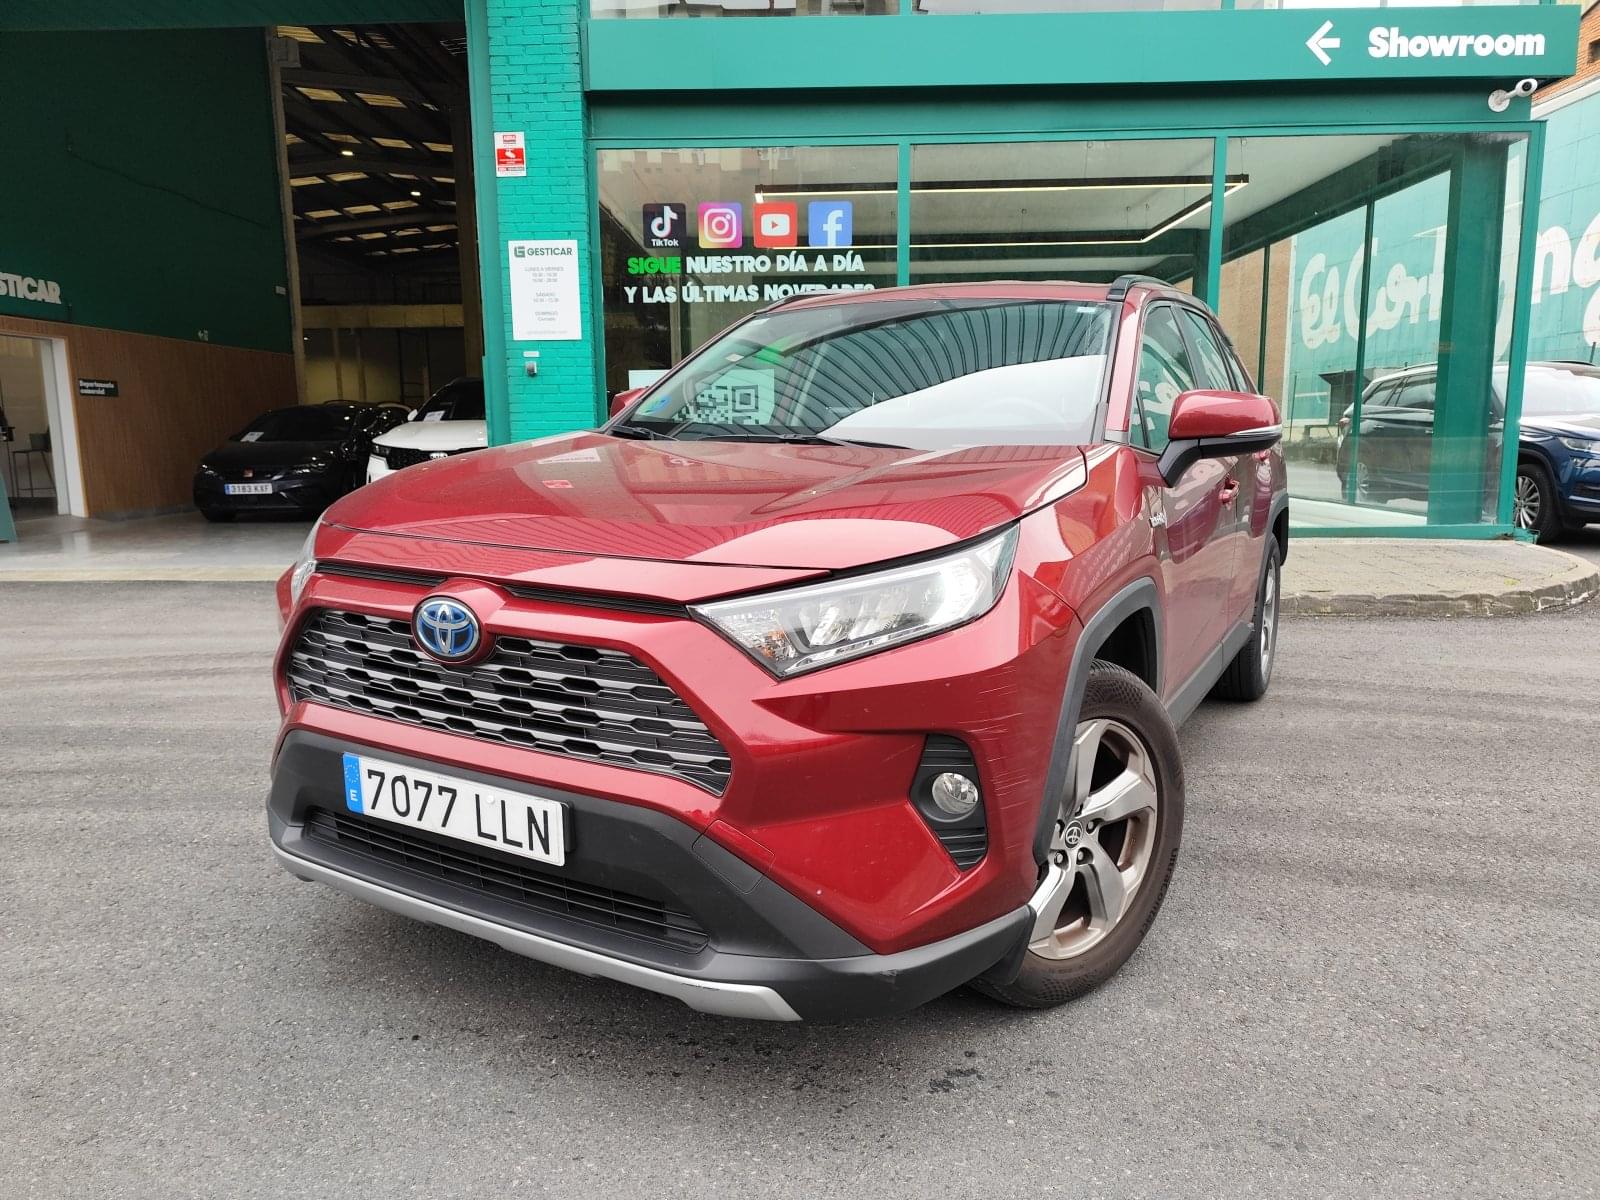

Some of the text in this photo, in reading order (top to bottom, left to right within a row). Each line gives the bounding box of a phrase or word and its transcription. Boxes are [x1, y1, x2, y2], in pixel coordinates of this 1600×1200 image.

[1368, 27, 1545, 58] Showroom
[527, 247, 573, 256] GESTICAR
[651, 238, 679, 247] TikTok
[628, 250, 865, 274] SIGUE NUESTRO DÍA A DÍA
[0, 271, 62, 304] STICAR
[624, 286, 638, 304] Y
[643, 285, 677, 303] LAS
[682, 281, 760, 303] ÚLTIMAS
[1344, 225, 1447, 342] Cort
[349, 789, 359, 801] E
[367, 768, 550, 855] 7077 LLN
